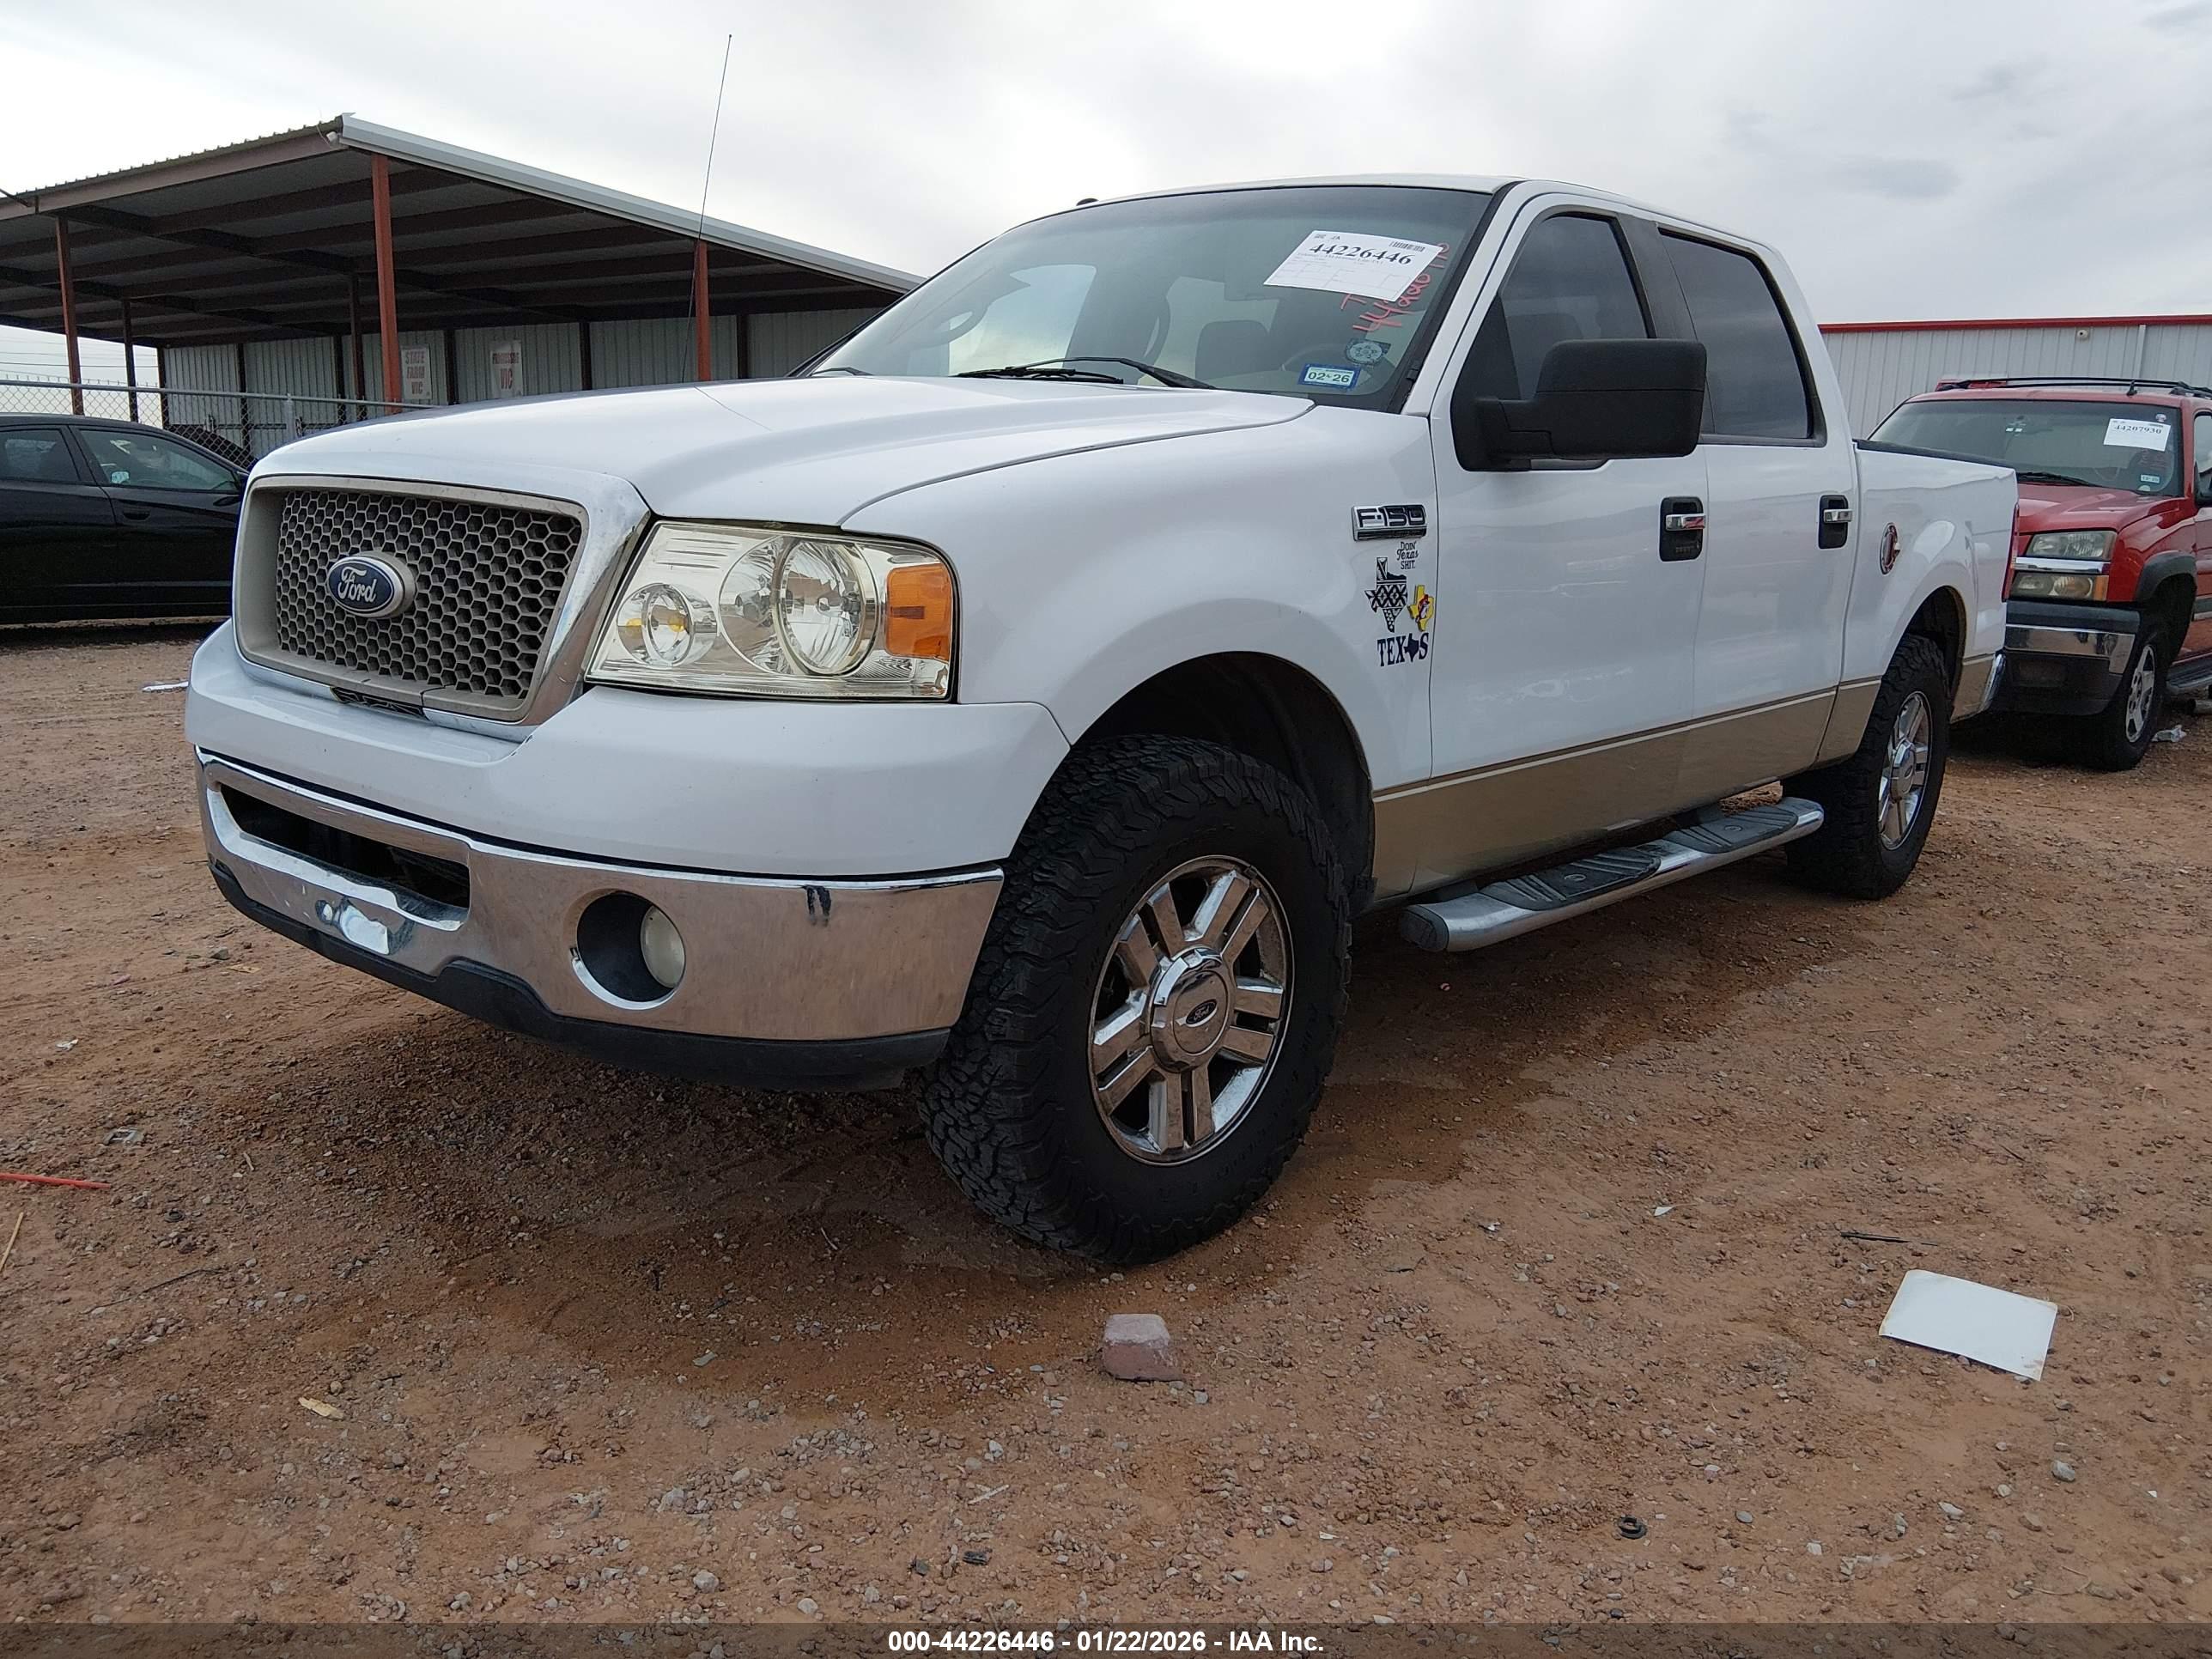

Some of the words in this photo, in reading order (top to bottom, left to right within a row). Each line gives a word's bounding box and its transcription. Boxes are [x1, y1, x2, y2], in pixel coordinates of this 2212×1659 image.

[1309, 242, 1415, 265] 44226446
[1356, 506, 1426, 528] F-150
[1396, 548, 1419, 561] Texas
[339, 566, 377, 603] Ford
